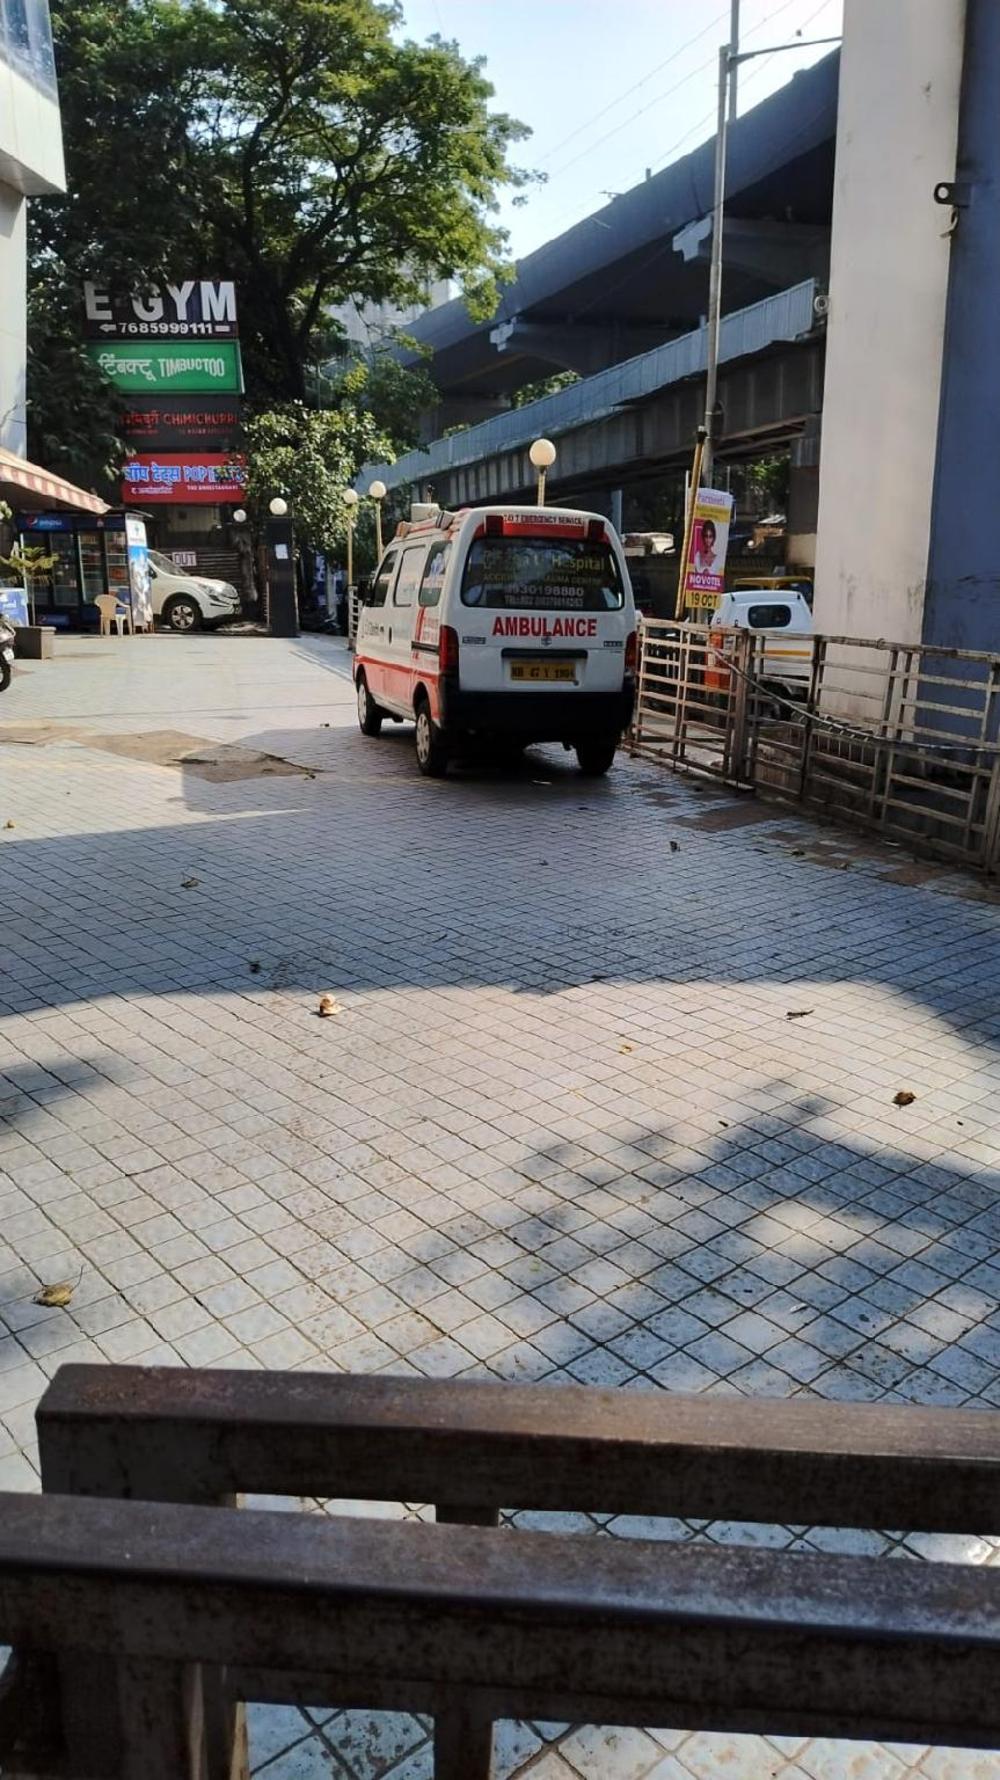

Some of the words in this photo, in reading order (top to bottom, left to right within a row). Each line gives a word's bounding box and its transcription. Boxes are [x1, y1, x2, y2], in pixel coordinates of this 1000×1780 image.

[131, 281, 237, 322] GYM
[119, 322, 213, 334] 7685999111
[158, 357, 225, 378] TIMBUCTOO
[163, 412, 238, 425] CHIMICHURRI
[183, 466, 208, 482] POP
[175, 553, 196, 565] OUT
[689, 573, 721, 587] NOVOTEL
[691, 592, 700, 606] 19
[701, 593, 718, 608] OCT
[492, 616, 598, 637] AMBULANCE
